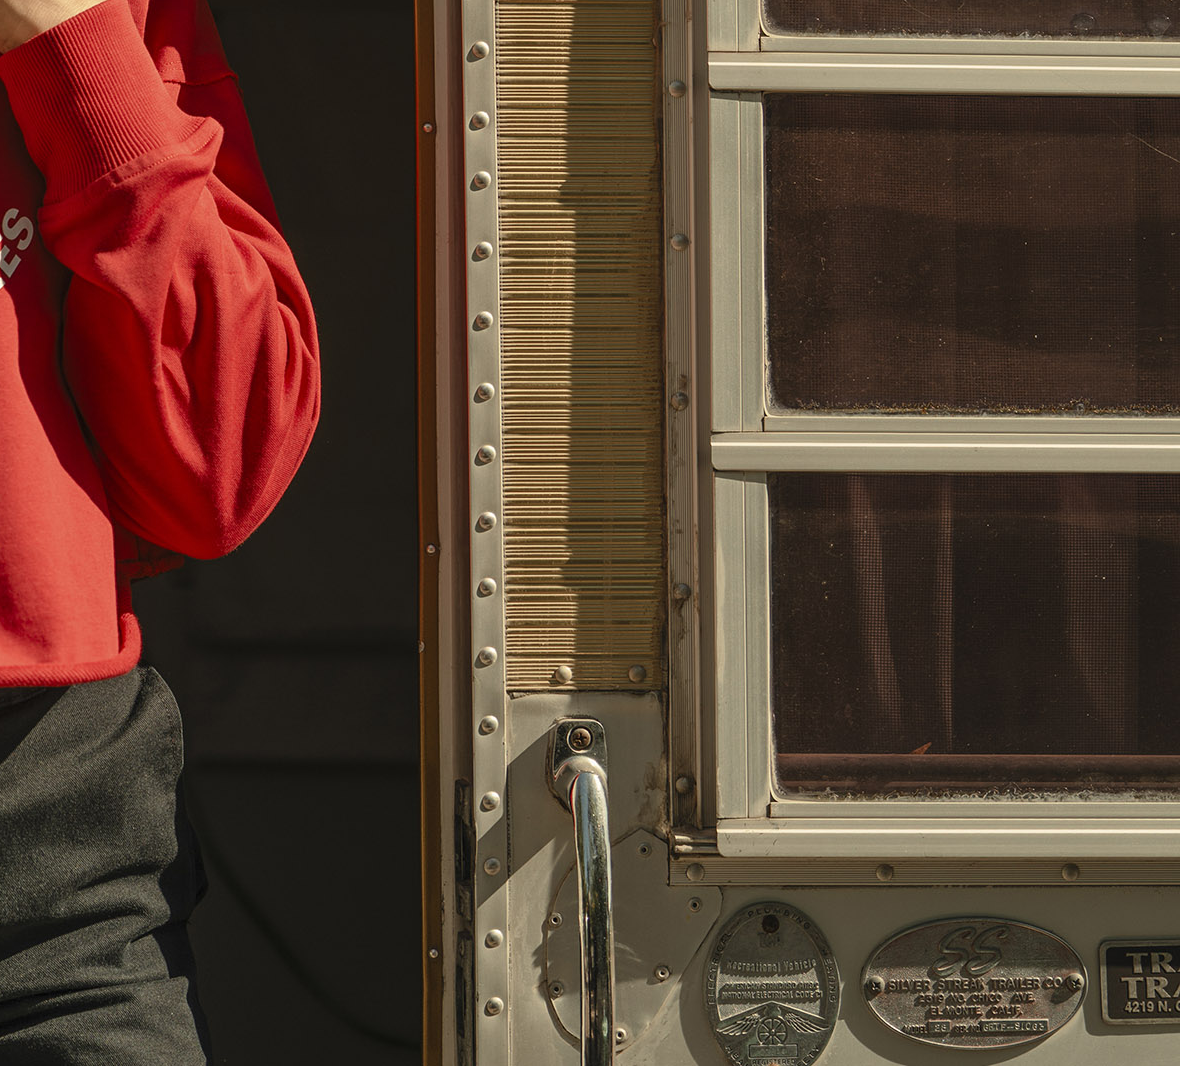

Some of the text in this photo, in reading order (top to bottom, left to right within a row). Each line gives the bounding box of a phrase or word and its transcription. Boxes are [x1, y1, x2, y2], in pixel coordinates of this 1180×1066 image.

[727, 958, 817, 973] Recreational Vehicle
[1126, 952, 1180, 973] TR
[888, 977, 931, 991] SILVER
[938, 977, 985, 991] STREAK
[992, 976, 1041, 990] TRAILER
[972, 992, 1003, 1003] CHICO
[1124, 1001, 1154, 1013] 4219
